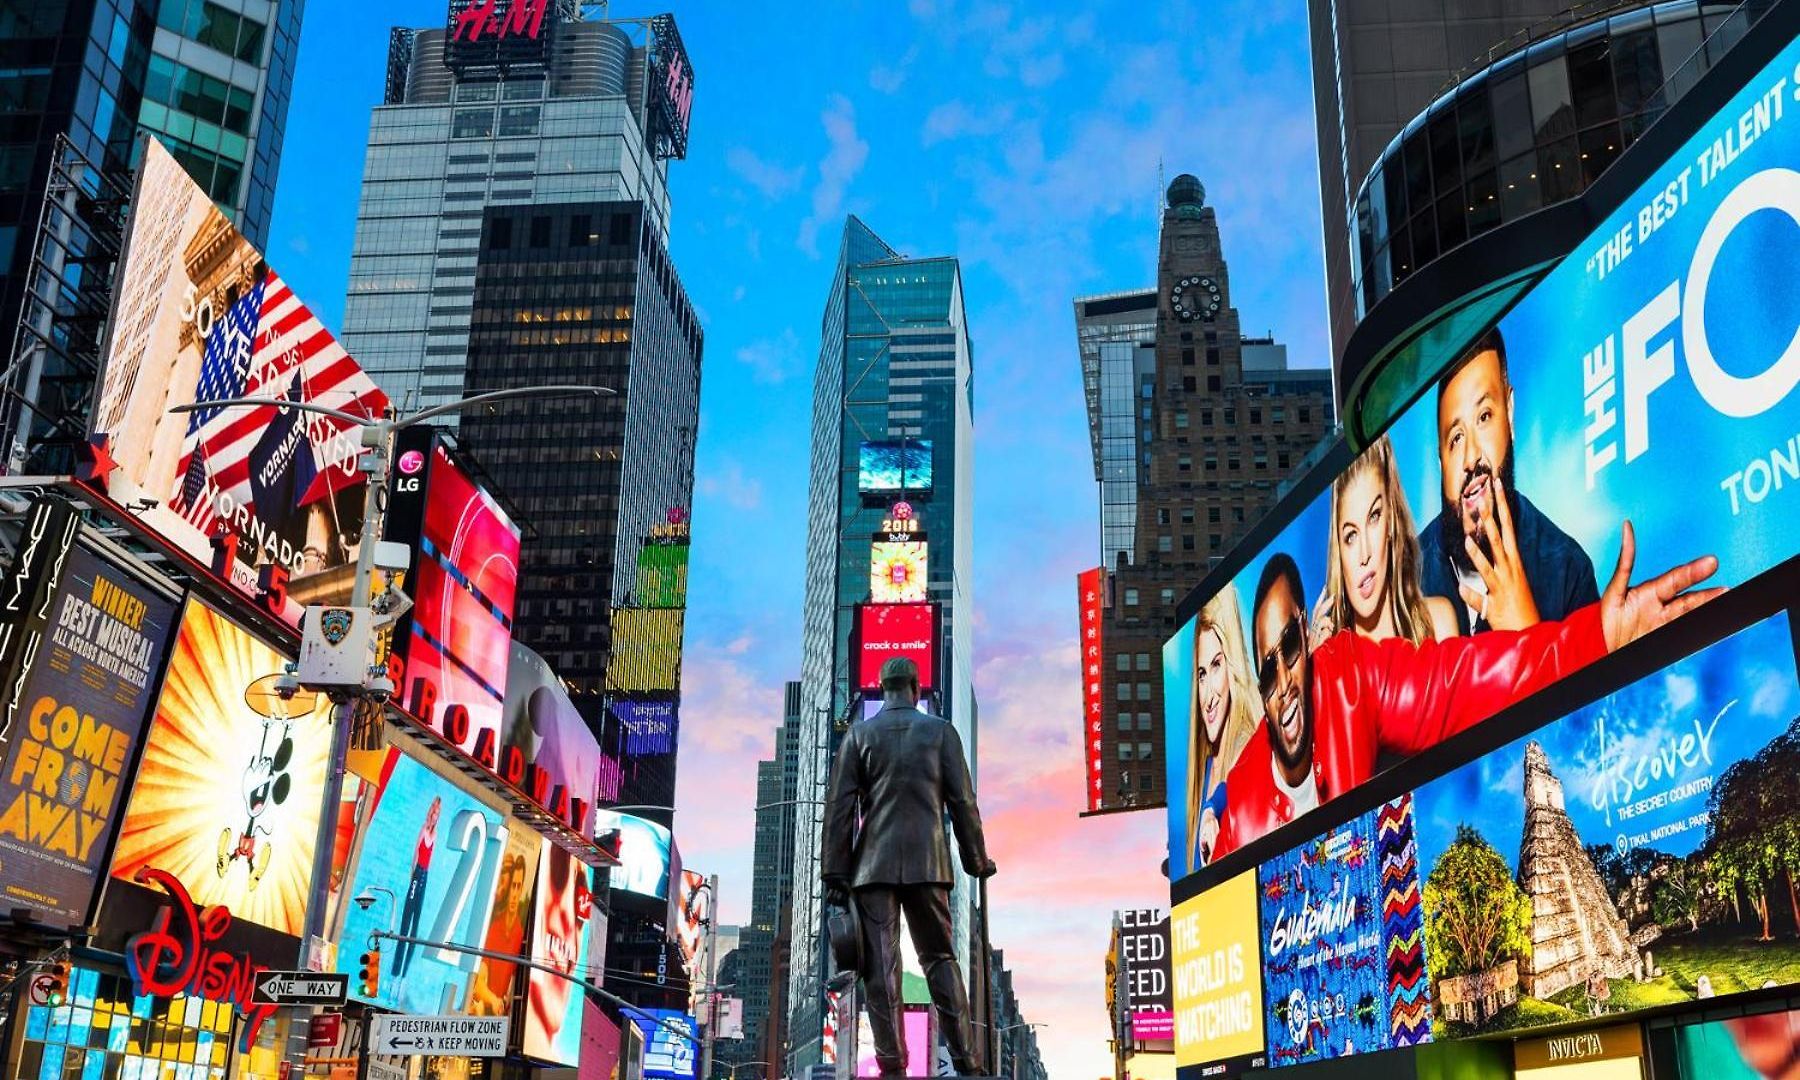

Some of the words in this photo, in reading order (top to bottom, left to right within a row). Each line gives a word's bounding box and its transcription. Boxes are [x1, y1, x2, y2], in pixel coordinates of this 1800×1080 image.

[450, 0, 547, 42] H&M
[666, 51, 692, 132] H&M
[1639, 166, 1692, 246] BEST
[1697, 76, 1787, 188] TALENT
[1583, 333, 1617, 491] THE
[397, 478, 419, 491] LG
[204, 476, 305, 576] VORNADO
[882, 520, 918, 532] 2018
[91, 574, 148, 632] WINNER!
[52, 626, 69, 647] ALL
[67, 635, 98, 662] ACROSS
[118, 661, 148, 690] AMERICA
[59, 593, 101, 640] BEST
[95, 614, 154, 673] MUSICAL
[864, 640, 891, 650] crack
[892, 642, 899, 650] a
[29, 696, 131, 776] COME
[386, 654, 588, 833] BROADWAY
[1592, 699, 1738, 828] discover
[10, 738, 119, 819] FROM
[1617, 804, 1636, 821] THE
[1635, 791, 1669, 814] SECRET
[1670, 775, 1713, 801] COUNTRY
[0, 790, 107, 862] AWAY
[1629, 834, 1650, 848] TIKAL
[1651, 821, 1688, 841] NATIONAL
[1689, 812, 1711, 829] PARK
[1174, 911, 1201, 955] THE
[1271, 874, 1356, 957] Guatemala
[268, 981, 295, 995] ONE
[307, 982, 336, 995] WAY
[1175, 951, 1226, 1001] WORLD
[1228, 943, 1244, 983] IS
[389, 1020, 447, 1034] PEDESTRIAN
[449, 1021, 475, 1034] FLOW
[477, 1021, 503, 1035] ZONE
[438, 1037, 463, 1051] KEEP
[464, 1037, 502, 1051] MOVING
[1178, 991, 1253, 1047] WATCHING
[1546, 1033, 1604, 1061] INVICTA
